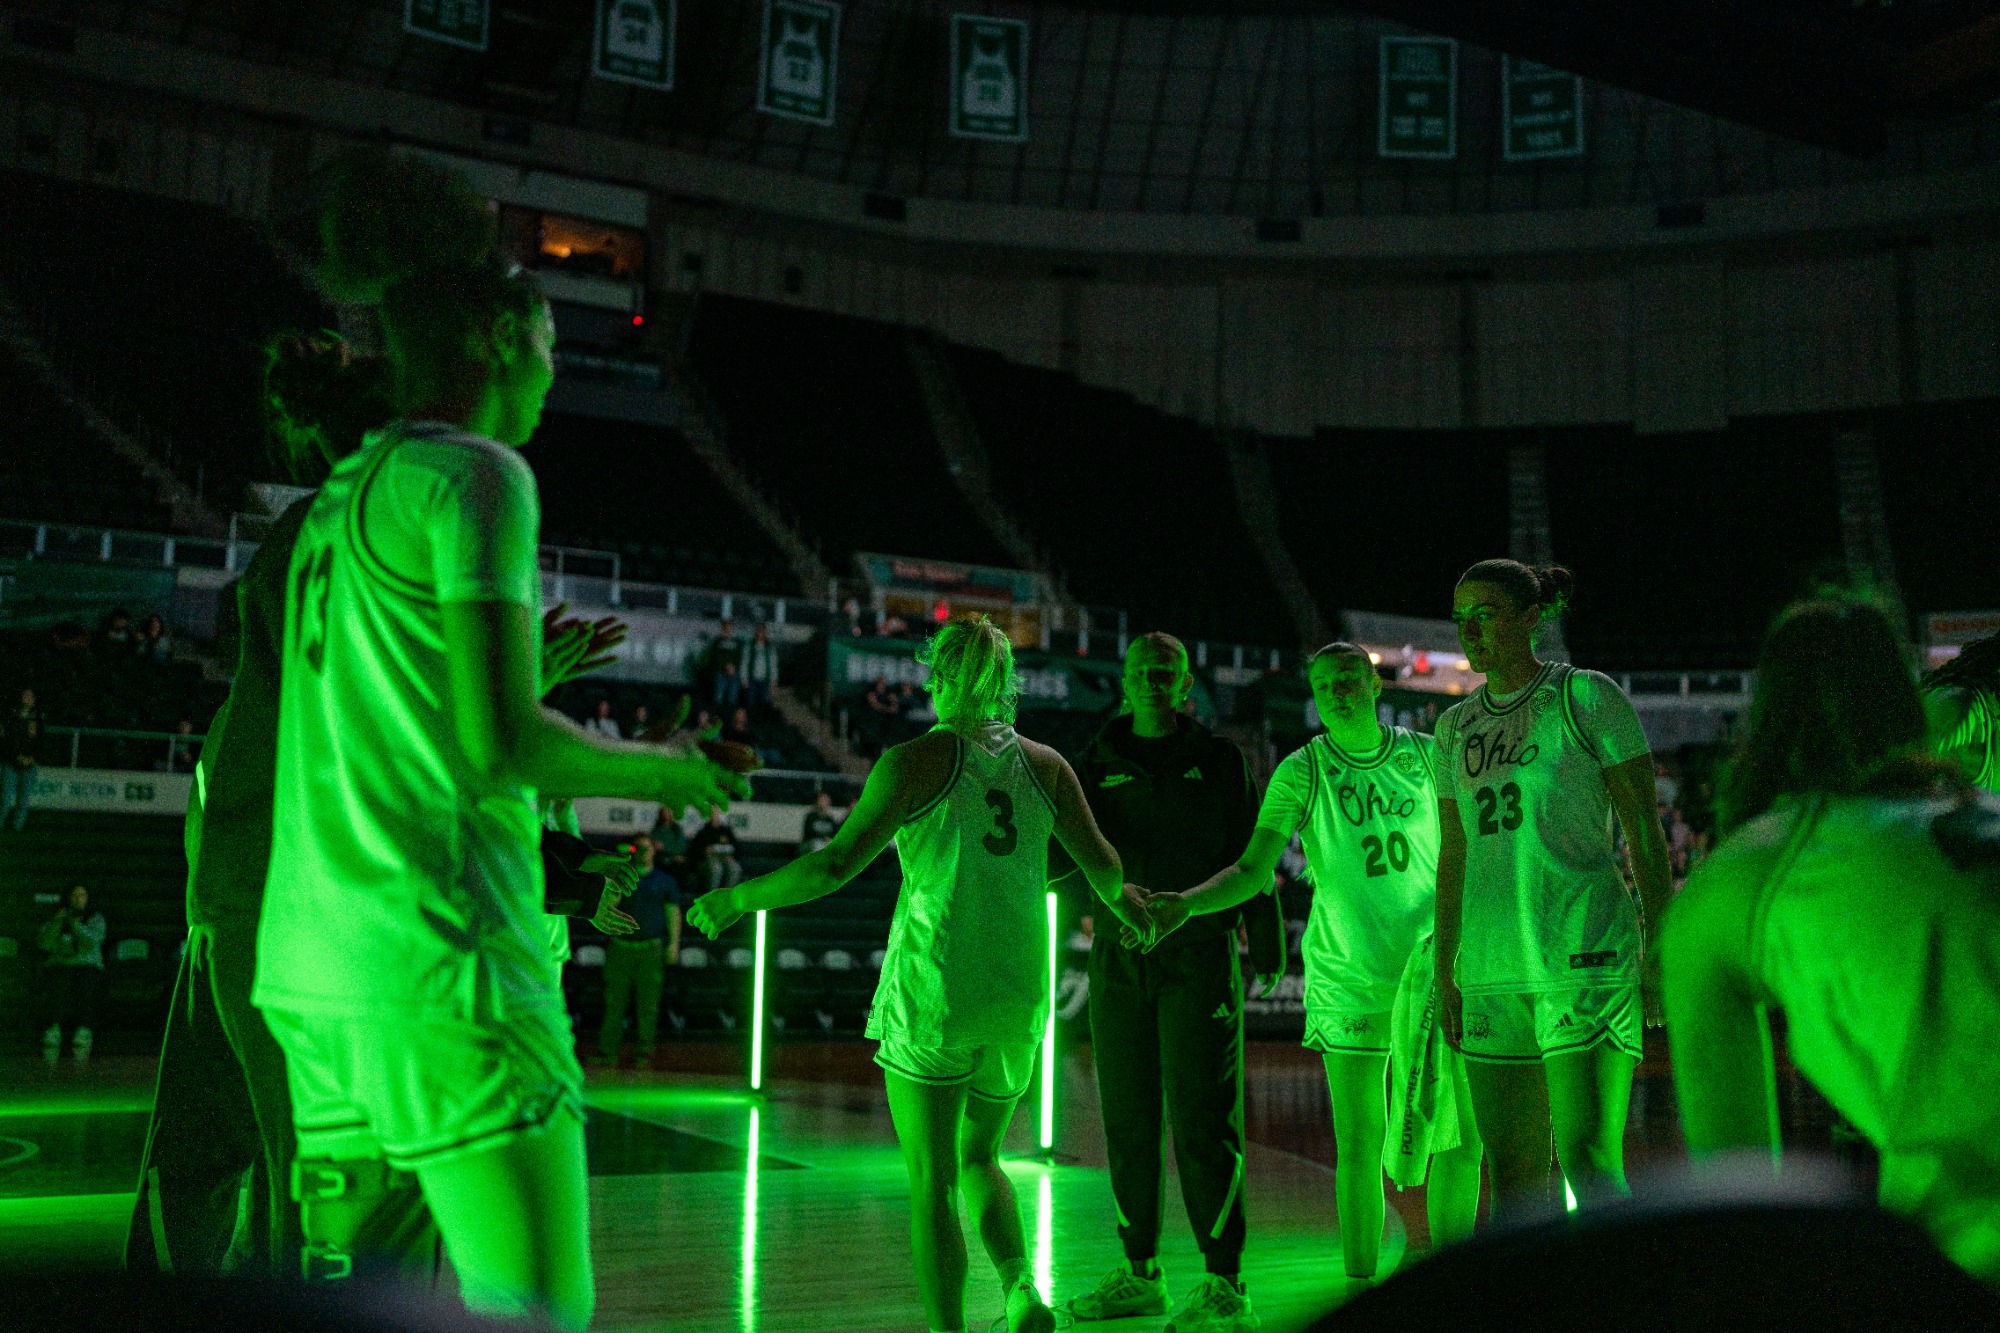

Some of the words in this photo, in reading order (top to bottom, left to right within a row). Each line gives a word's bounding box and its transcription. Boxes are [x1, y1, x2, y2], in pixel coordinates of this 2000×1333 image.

[1464, 730, 1540, 778] Ohio
[982, 788, 1018, 857] 3
[1337, 783, 1416, 828] Ohio
[1474, 781, 1525, 837] 23
[1360, 830, 1410, 878] 20
